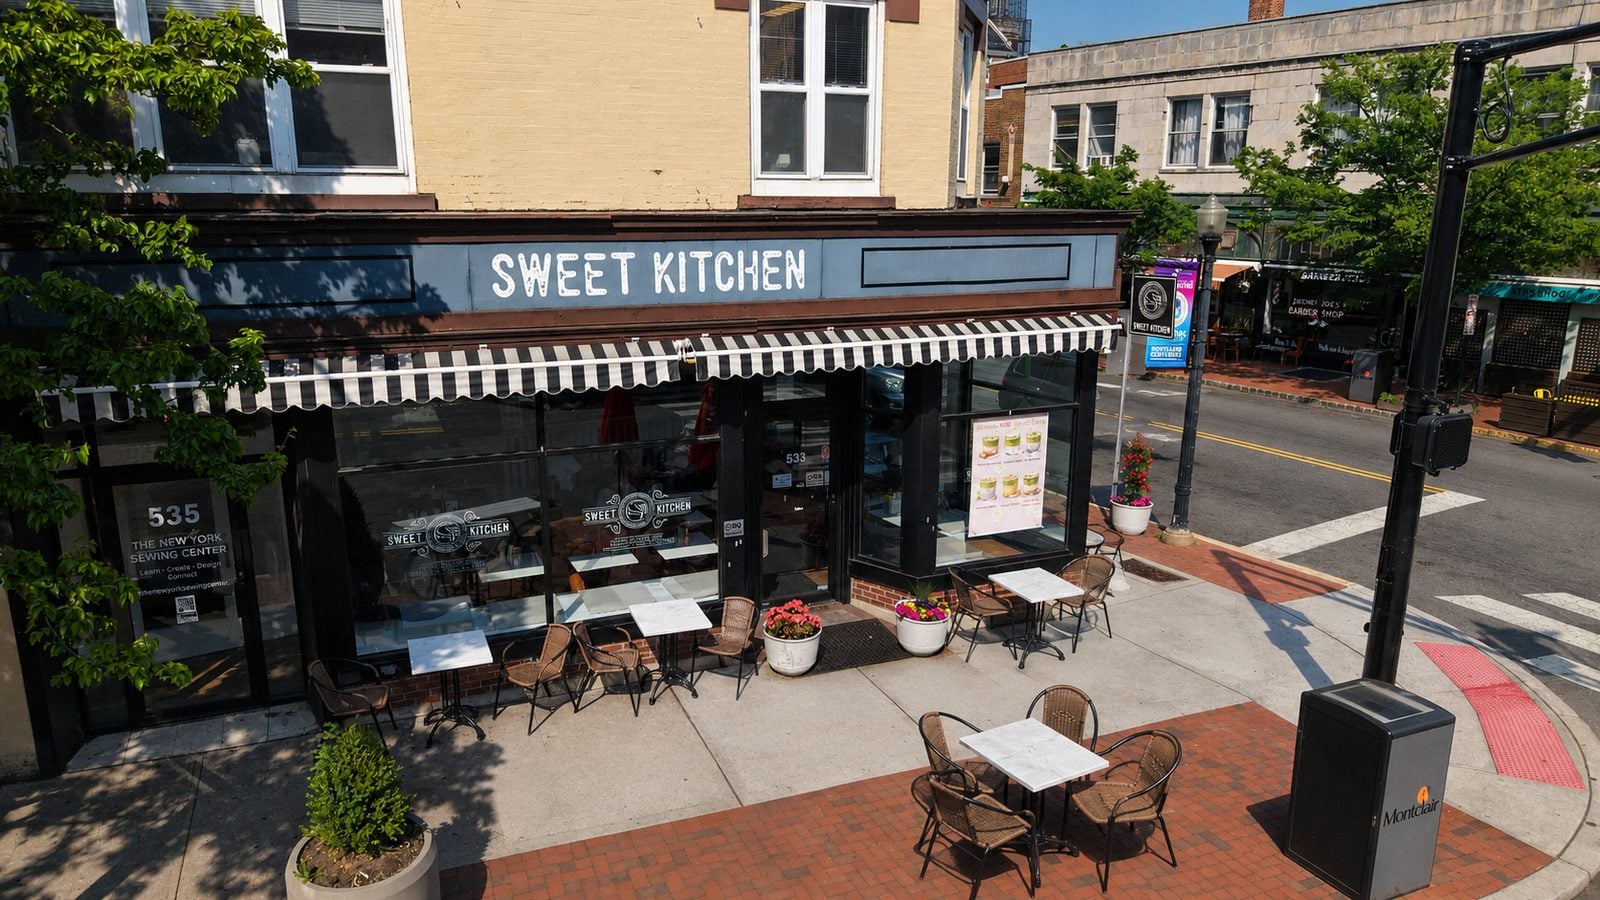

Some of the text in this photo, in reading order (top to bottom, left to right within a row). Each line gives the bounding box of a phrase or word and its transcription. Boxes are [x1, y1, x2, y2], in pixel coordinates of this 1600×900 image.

[491, 249, 805, 298] SWEET KITCHEN
[1321, 309, 1344, 318] SHOP
[786, 452, 806, 464] 533
[148, 503, 200, 527] 535
[585, 501, 692, 522] SWEET KITCHEN
[132, 532, 222, 550] THE NEW YORK
[387, 522, 509, 546] SWEET KITCHEN
[130, 545, 227, 564] SEWING CENTER
[139, 561, 222, 577] Learn Create Design
[167, 571, 198, 581] Connect
[1383, 798, 1440, 827] Montclair
